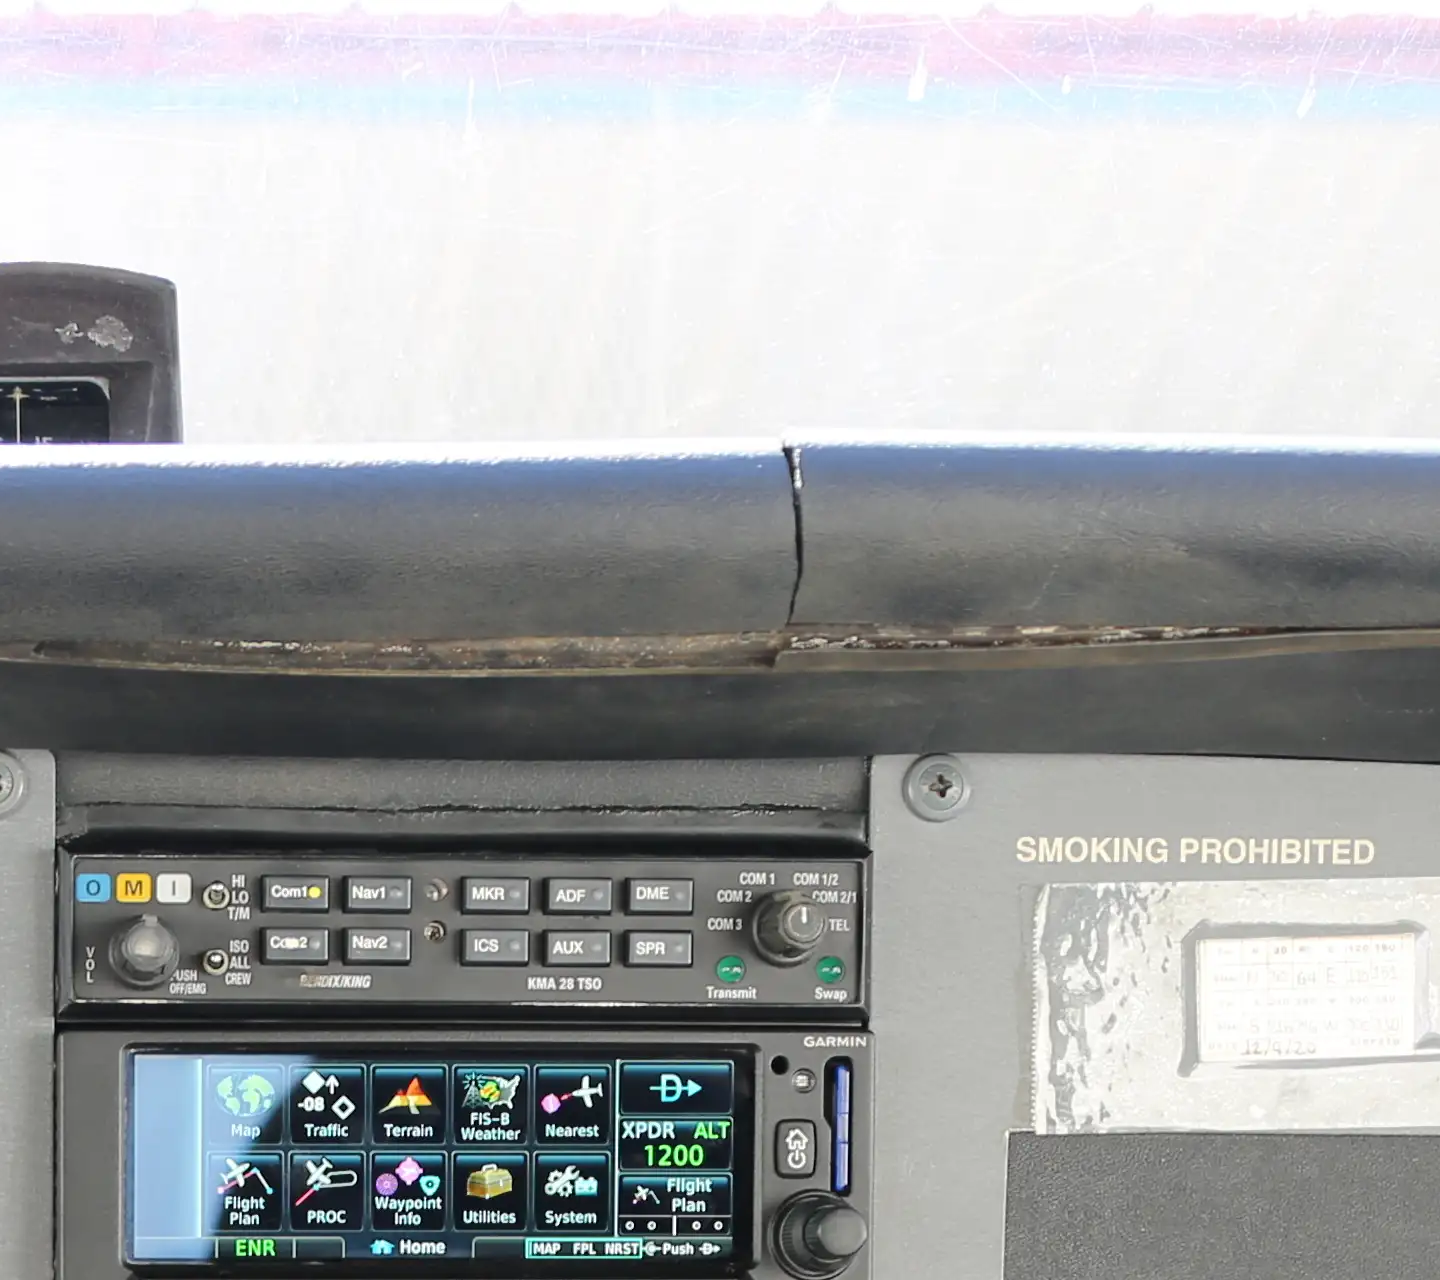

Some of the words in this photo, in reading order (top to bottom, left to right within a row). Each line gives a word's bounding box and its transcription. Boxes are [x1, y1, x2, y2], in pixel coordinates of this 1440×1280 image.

[1016, 836, 1169, 864] SMOKING
[1179, 837, 1375, 865] PROHIBITED
[271, 884, 308, 898] Com1
[352, 885, 386, 900] Nav1
[472, 886, 505, 901] MKR
[555, 889, 586, 903] ADF
[635, 886, 670, 900] DME
[352, 935, 388, 949] Nav2
[474, 938, 499, 953] ICS
[552, 940, 584, 955] AUX
[635, 941, 666, 956] SPR
[527, 977, 557, 990] KMA
[558, 977, 575, 991] 28
[577, 977, 602, 991] TSO
[706, 985, 757, 1000] Transmit
[814, 986, 848, 1003] Swap
[803, 1035, 867, 1048] GARMIN
[230, 1123, 261, 1140] Map
[303, 1123, 349, 1138] Traffic
[383, 1123, 434, 1138] Terrain
[460, 1126, 521, 1146] Weather
[545, 1123, 600, 1138] Nearest
[621, 1120, 675, 1140] XPDR
[693, 1121, 734, 1141] ALT
[644, 1144, 704, 1167] 1200
[224, 1195, 266, 1214] Flight
[374, 1195, 443, 1213] Waypoint
[229, 1211, 260, 1226] Plan
[307, 1209, 347, 1224] PROC
[394, 1211, 422, 1226] Info
[463, 1209, 517, 1224] Utilities
[544, 1210, 597, 1227] System
[234, 1235, 277, 1257] ENR
[399, 1239, 446, 1255] Home
